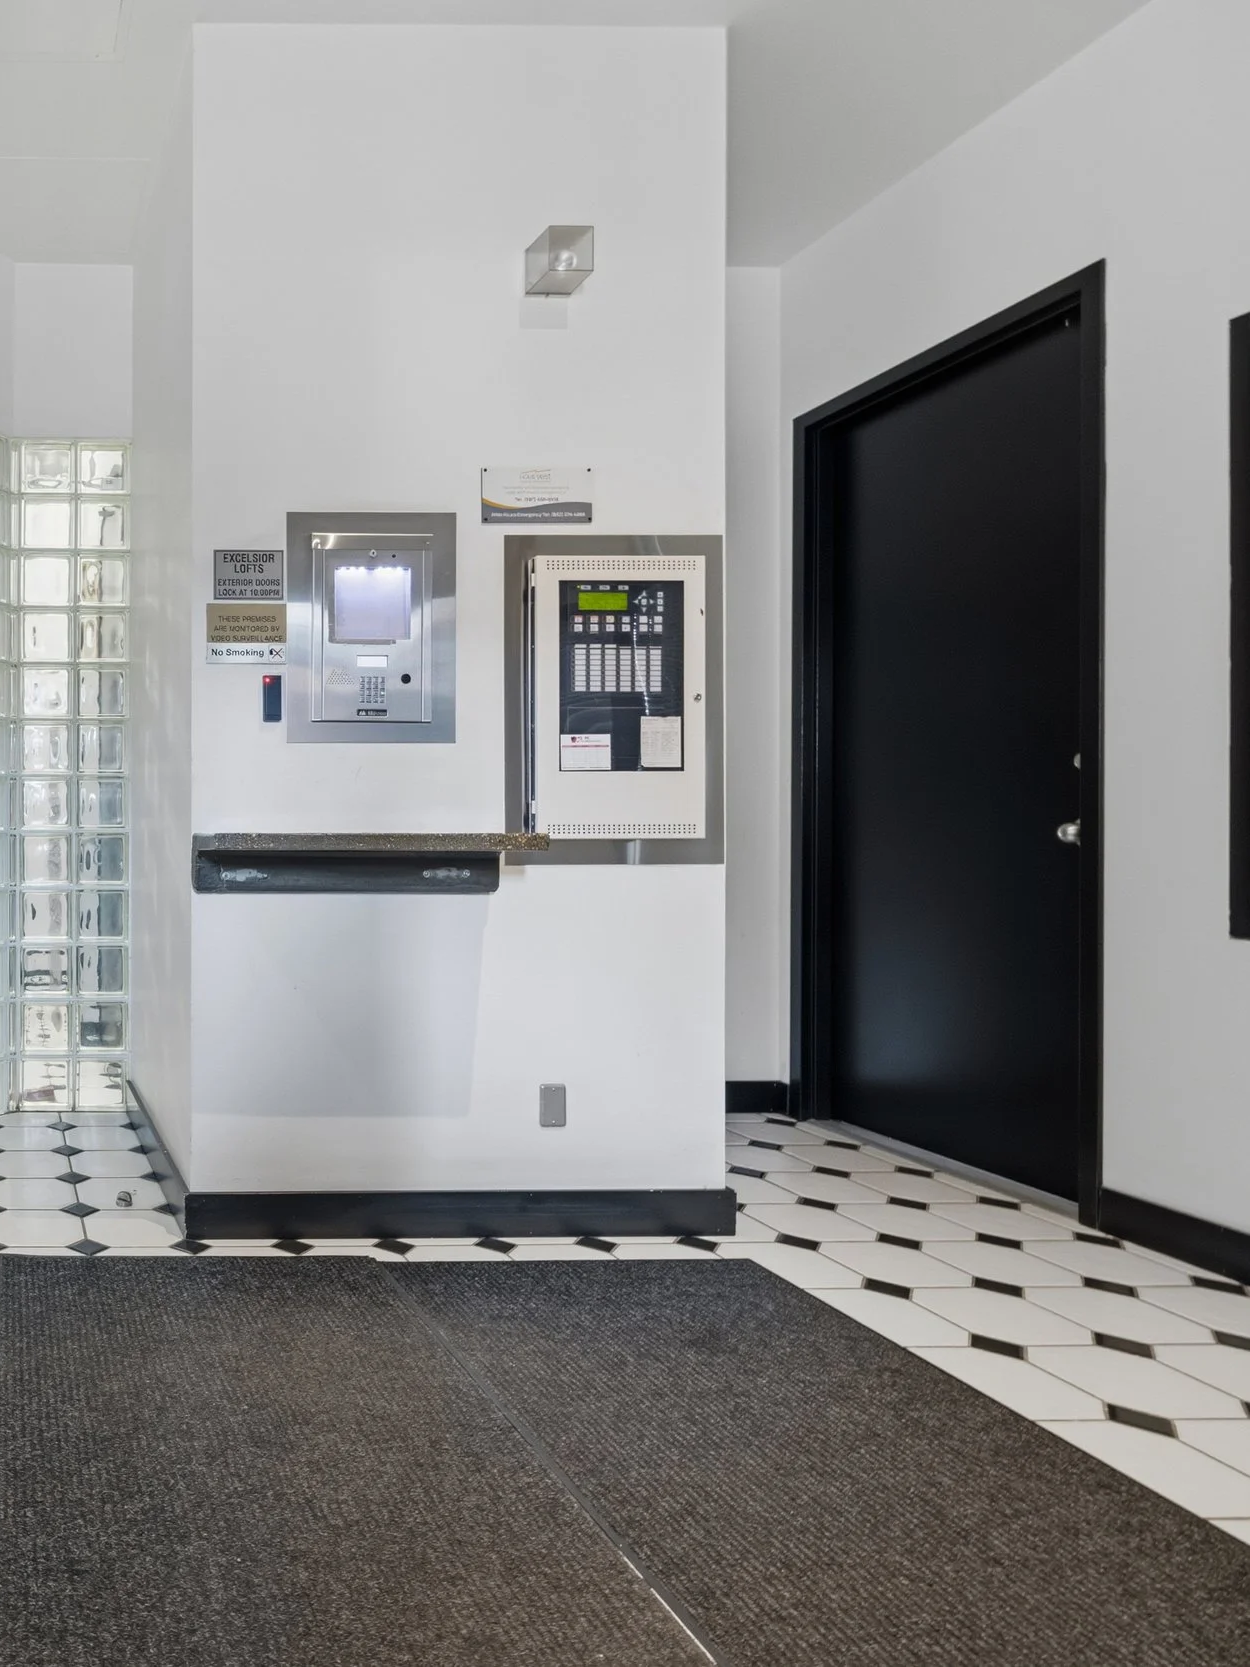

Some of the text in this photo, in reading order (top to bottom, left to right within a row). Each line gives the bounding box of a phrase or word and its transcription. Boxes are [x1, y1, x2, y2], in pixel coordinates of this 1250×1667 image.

[223, 553, 275, 563] EXCELSIOR
[234, 564, 264, 573] LOFTS
[211, 648, 264, 657] No Smoking
